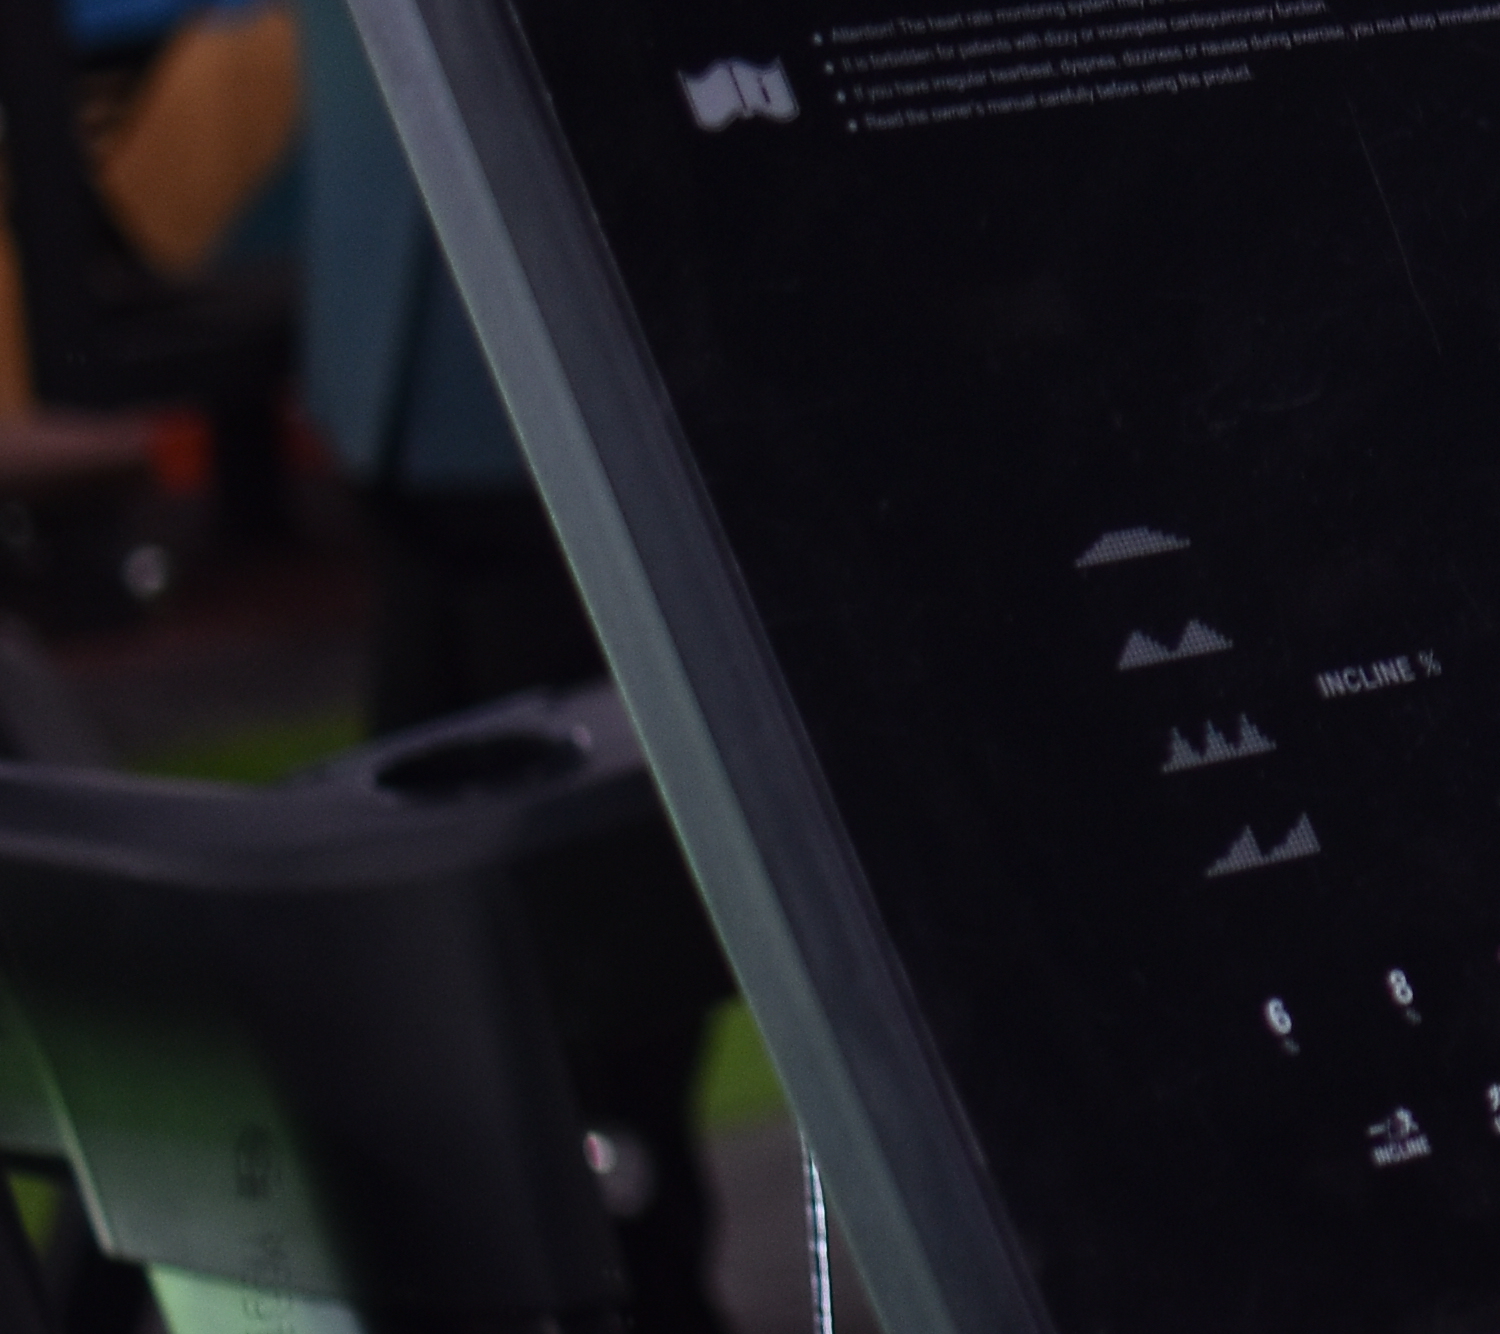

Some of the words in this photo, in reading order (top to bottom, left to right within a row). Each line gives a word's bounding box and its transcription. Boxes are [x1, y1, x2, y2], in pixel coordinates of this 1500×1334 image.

[1316, 654, 1416, 699] INCLINE
[1418, 648, 1442, 676] %
[1387, 968, 1414, 1006] 8
[1265, 997, 1293, 1036] 6
[1371, 1134, 1433, 1166] INCLINE
